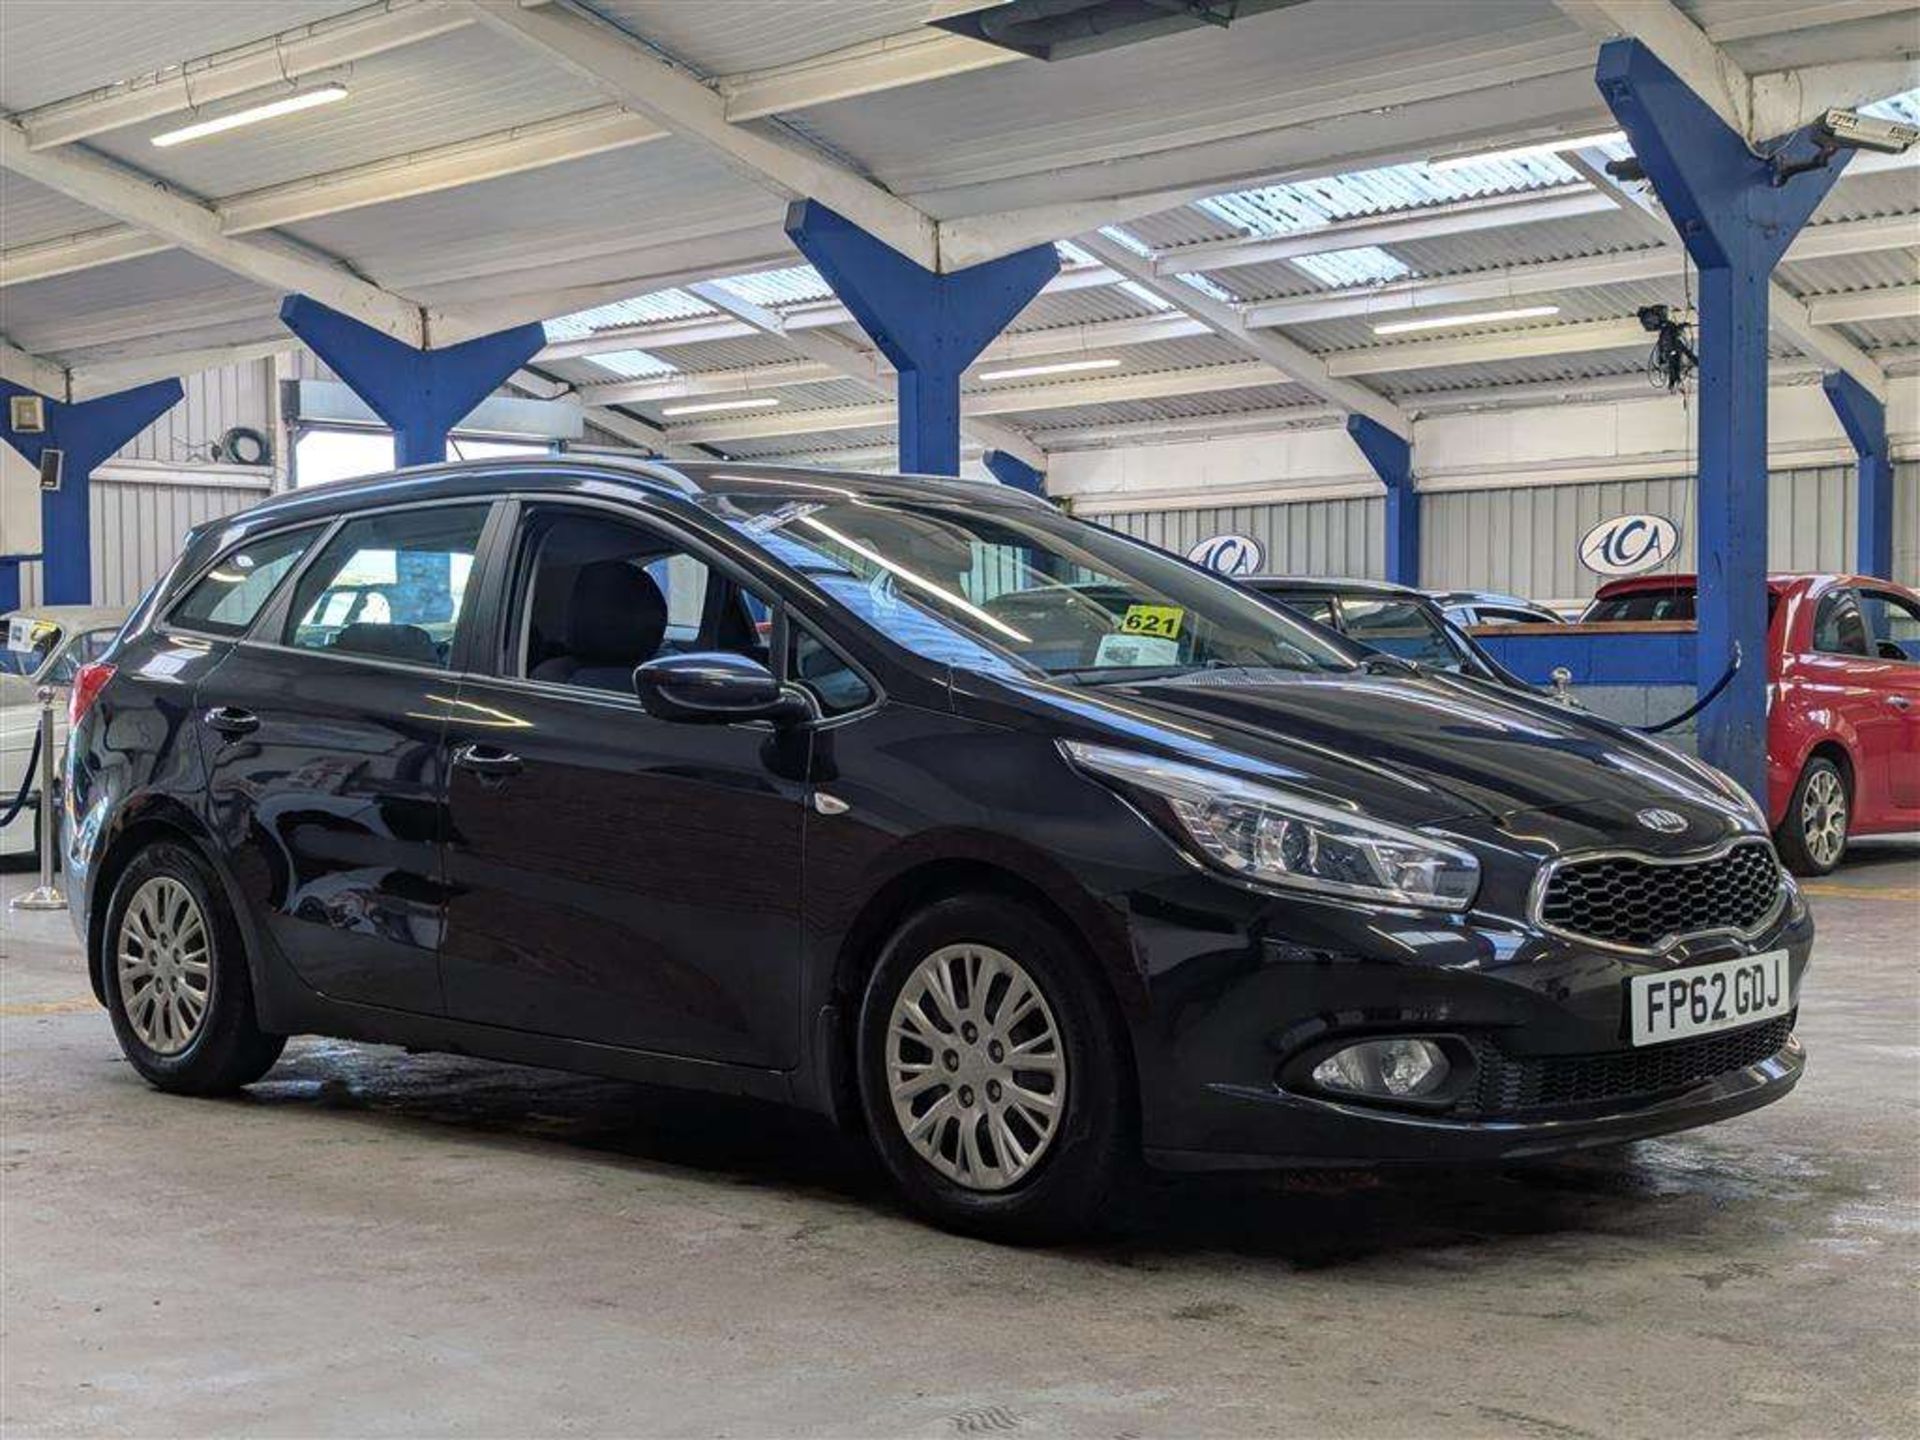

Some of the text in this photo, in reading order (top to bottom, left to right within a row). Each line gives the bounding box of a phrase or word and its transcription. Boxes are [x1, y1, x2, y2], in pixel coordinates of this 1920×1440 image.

[1584, 519, 1663, 567] ACA
[1126, 614, 1175, 634] 621
[1647, 959, 1780, 1033] FP62 GDJ
